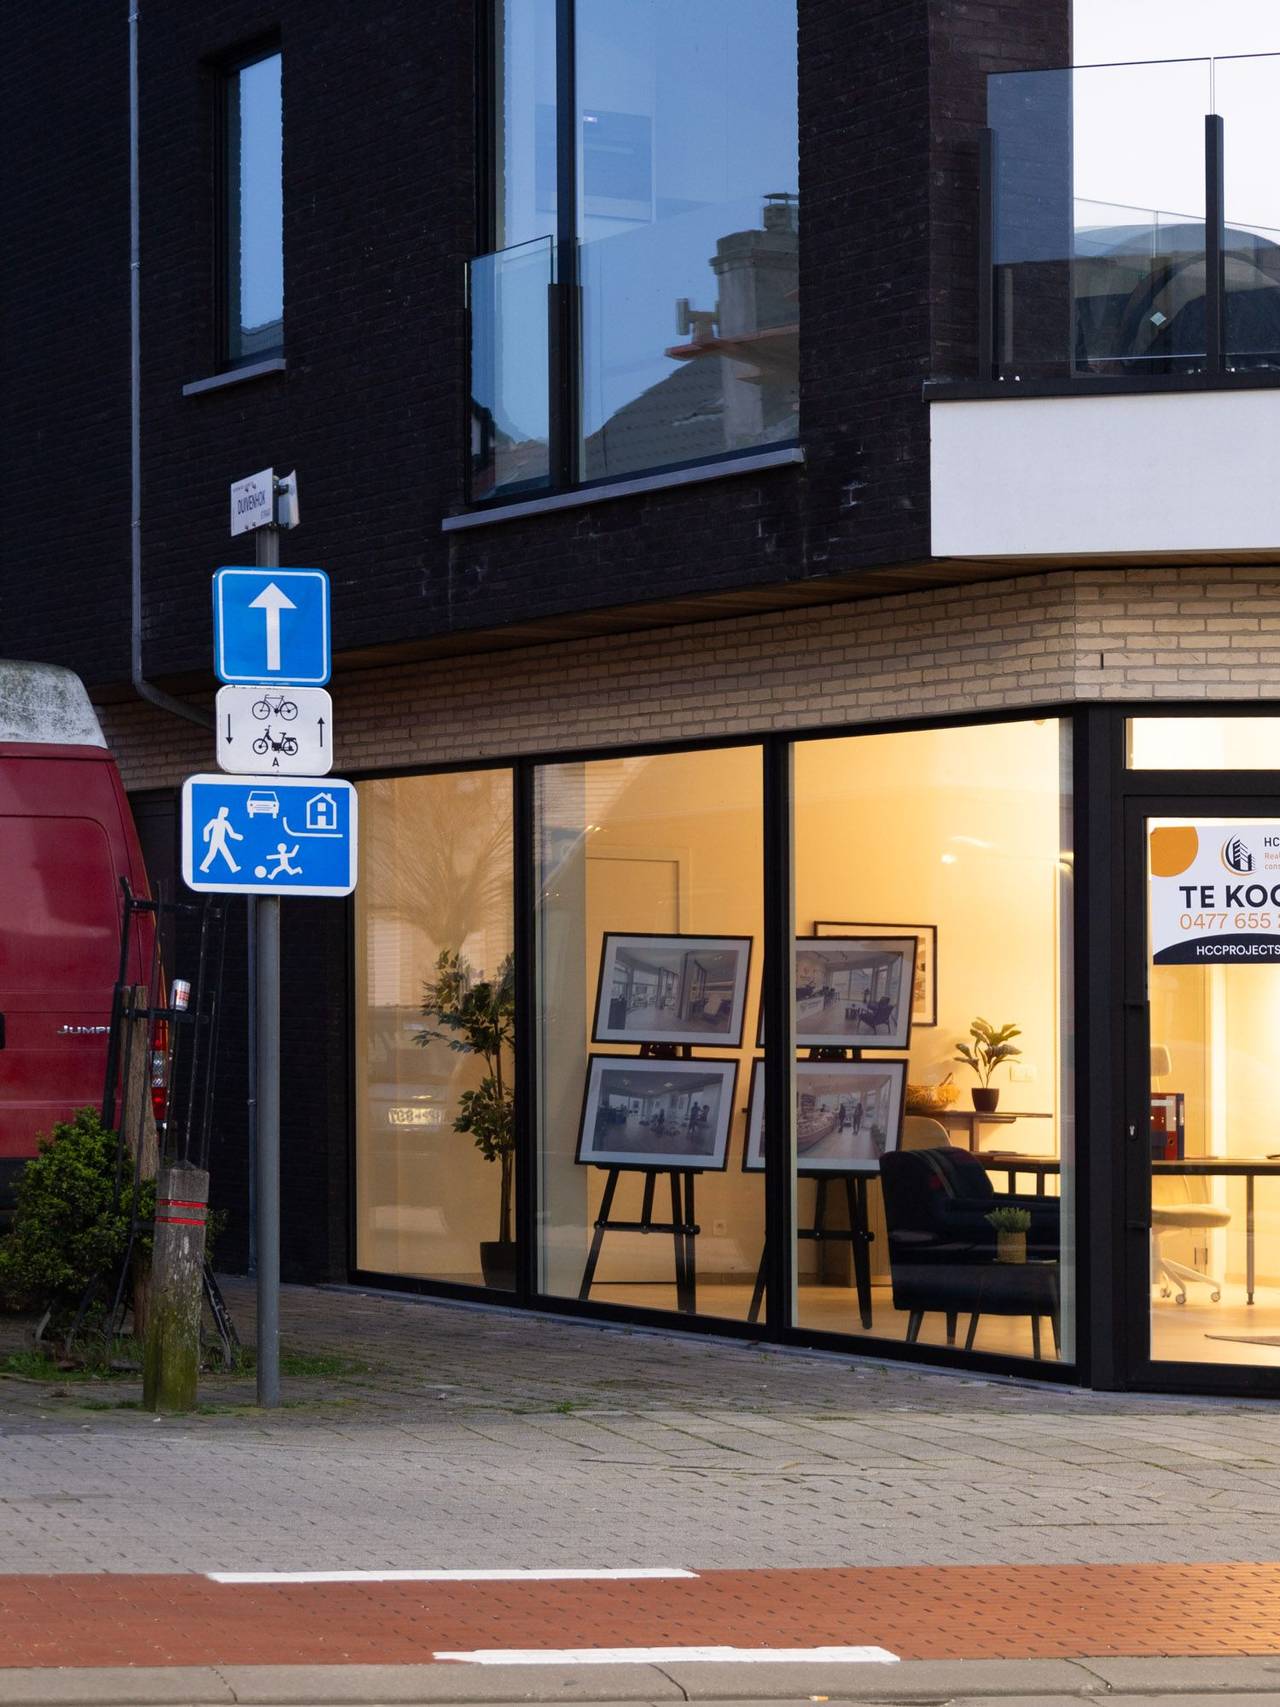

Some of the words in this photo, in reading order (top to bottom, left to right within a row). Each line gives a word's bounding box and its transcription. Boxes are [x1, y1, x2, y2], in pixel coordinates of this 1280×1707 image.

[272, 757, 279, 766] A
[1179, 886, 1214, 908] TE
[1180, 913, 1228, 929] 0477
[1235, 910, 1271, 929] 655
